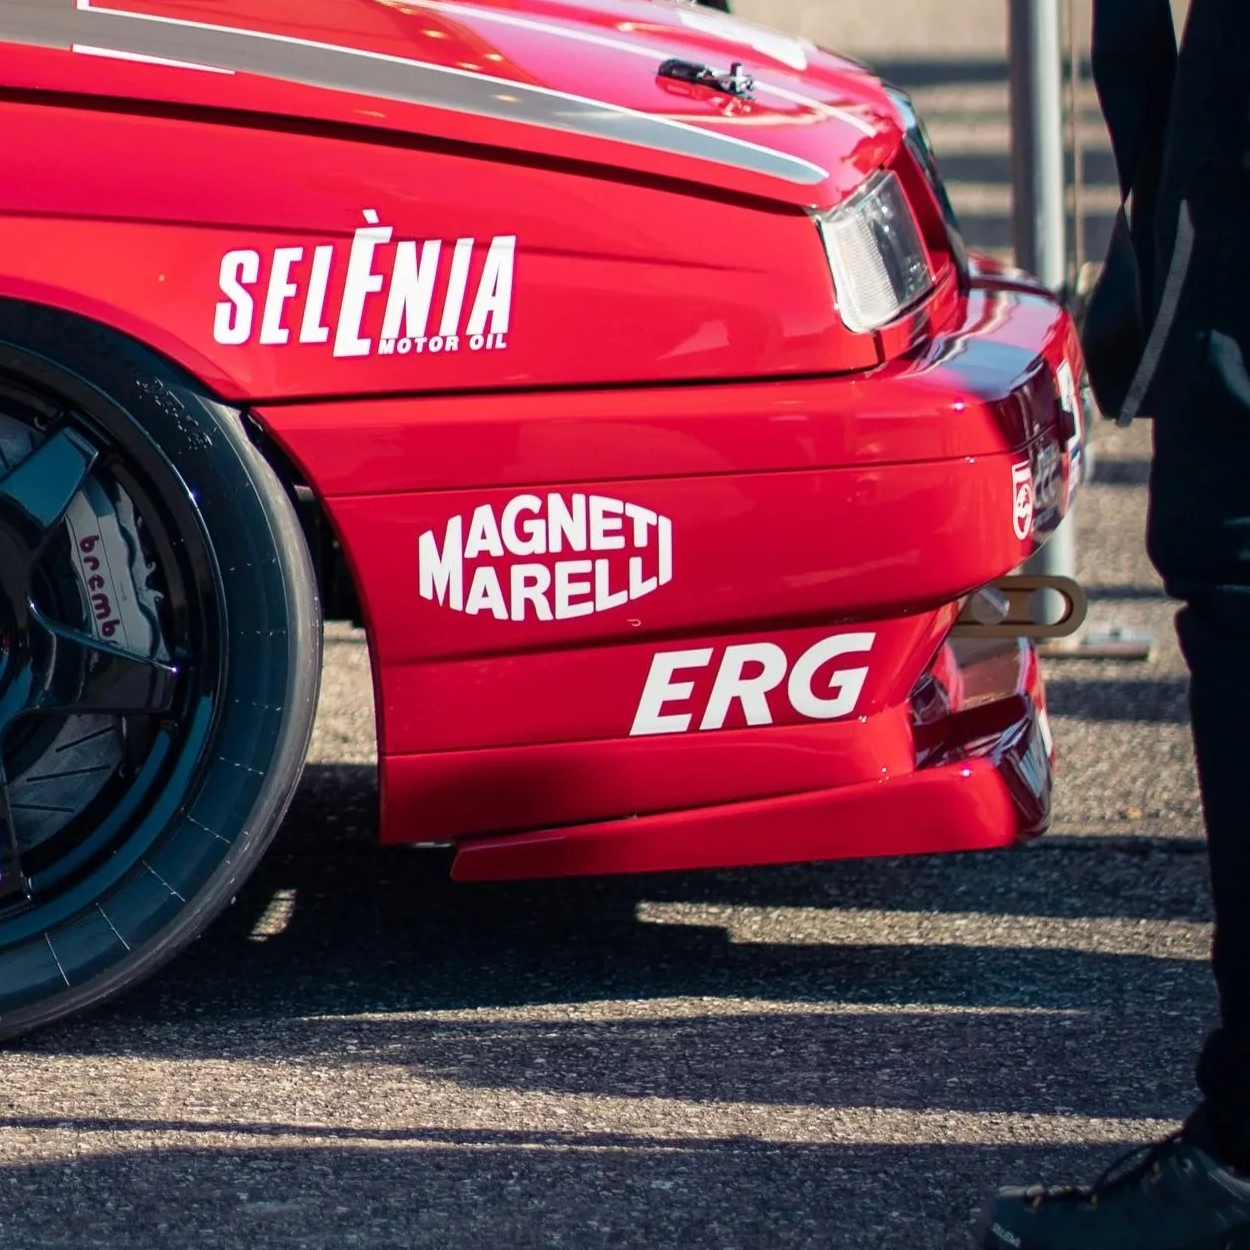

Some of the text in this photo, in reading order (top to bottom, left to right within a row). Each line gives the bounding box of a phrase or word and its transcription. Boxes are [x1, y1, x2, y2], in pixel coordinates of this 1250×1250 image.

[377, 332, 508, 355] MOTOR OIL
[77, 533, 118, 639] bremb
[629, 632, 876, 736] ERG
